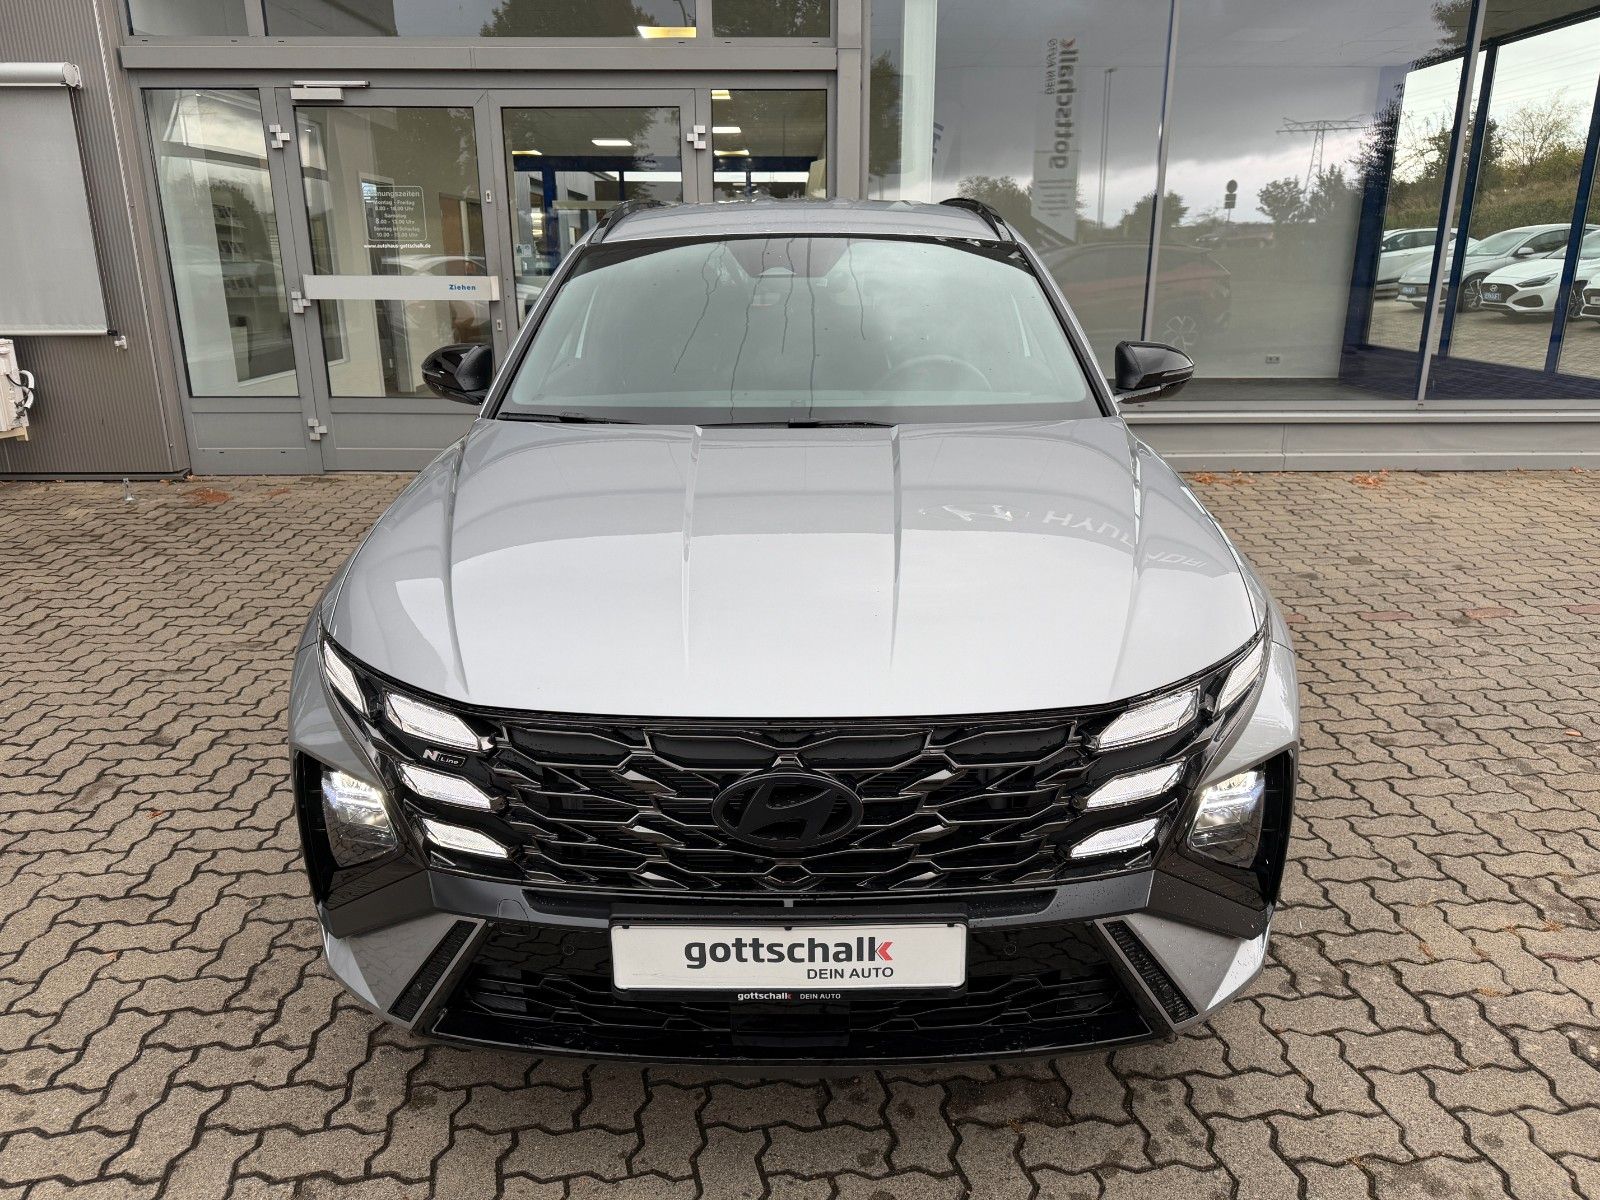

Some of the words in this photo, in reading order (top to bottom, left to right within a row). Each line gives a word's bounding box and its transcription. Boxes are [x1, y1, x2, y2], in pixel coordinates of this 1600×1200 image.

[440, 756, 459, 765] Line
[684, 936, 894, 969] gottschalk
[807, 968, 844, 980] DEIN
[849, 966, 894, 979] AUTO
[737, 991, 793, 1002] gottschalk
